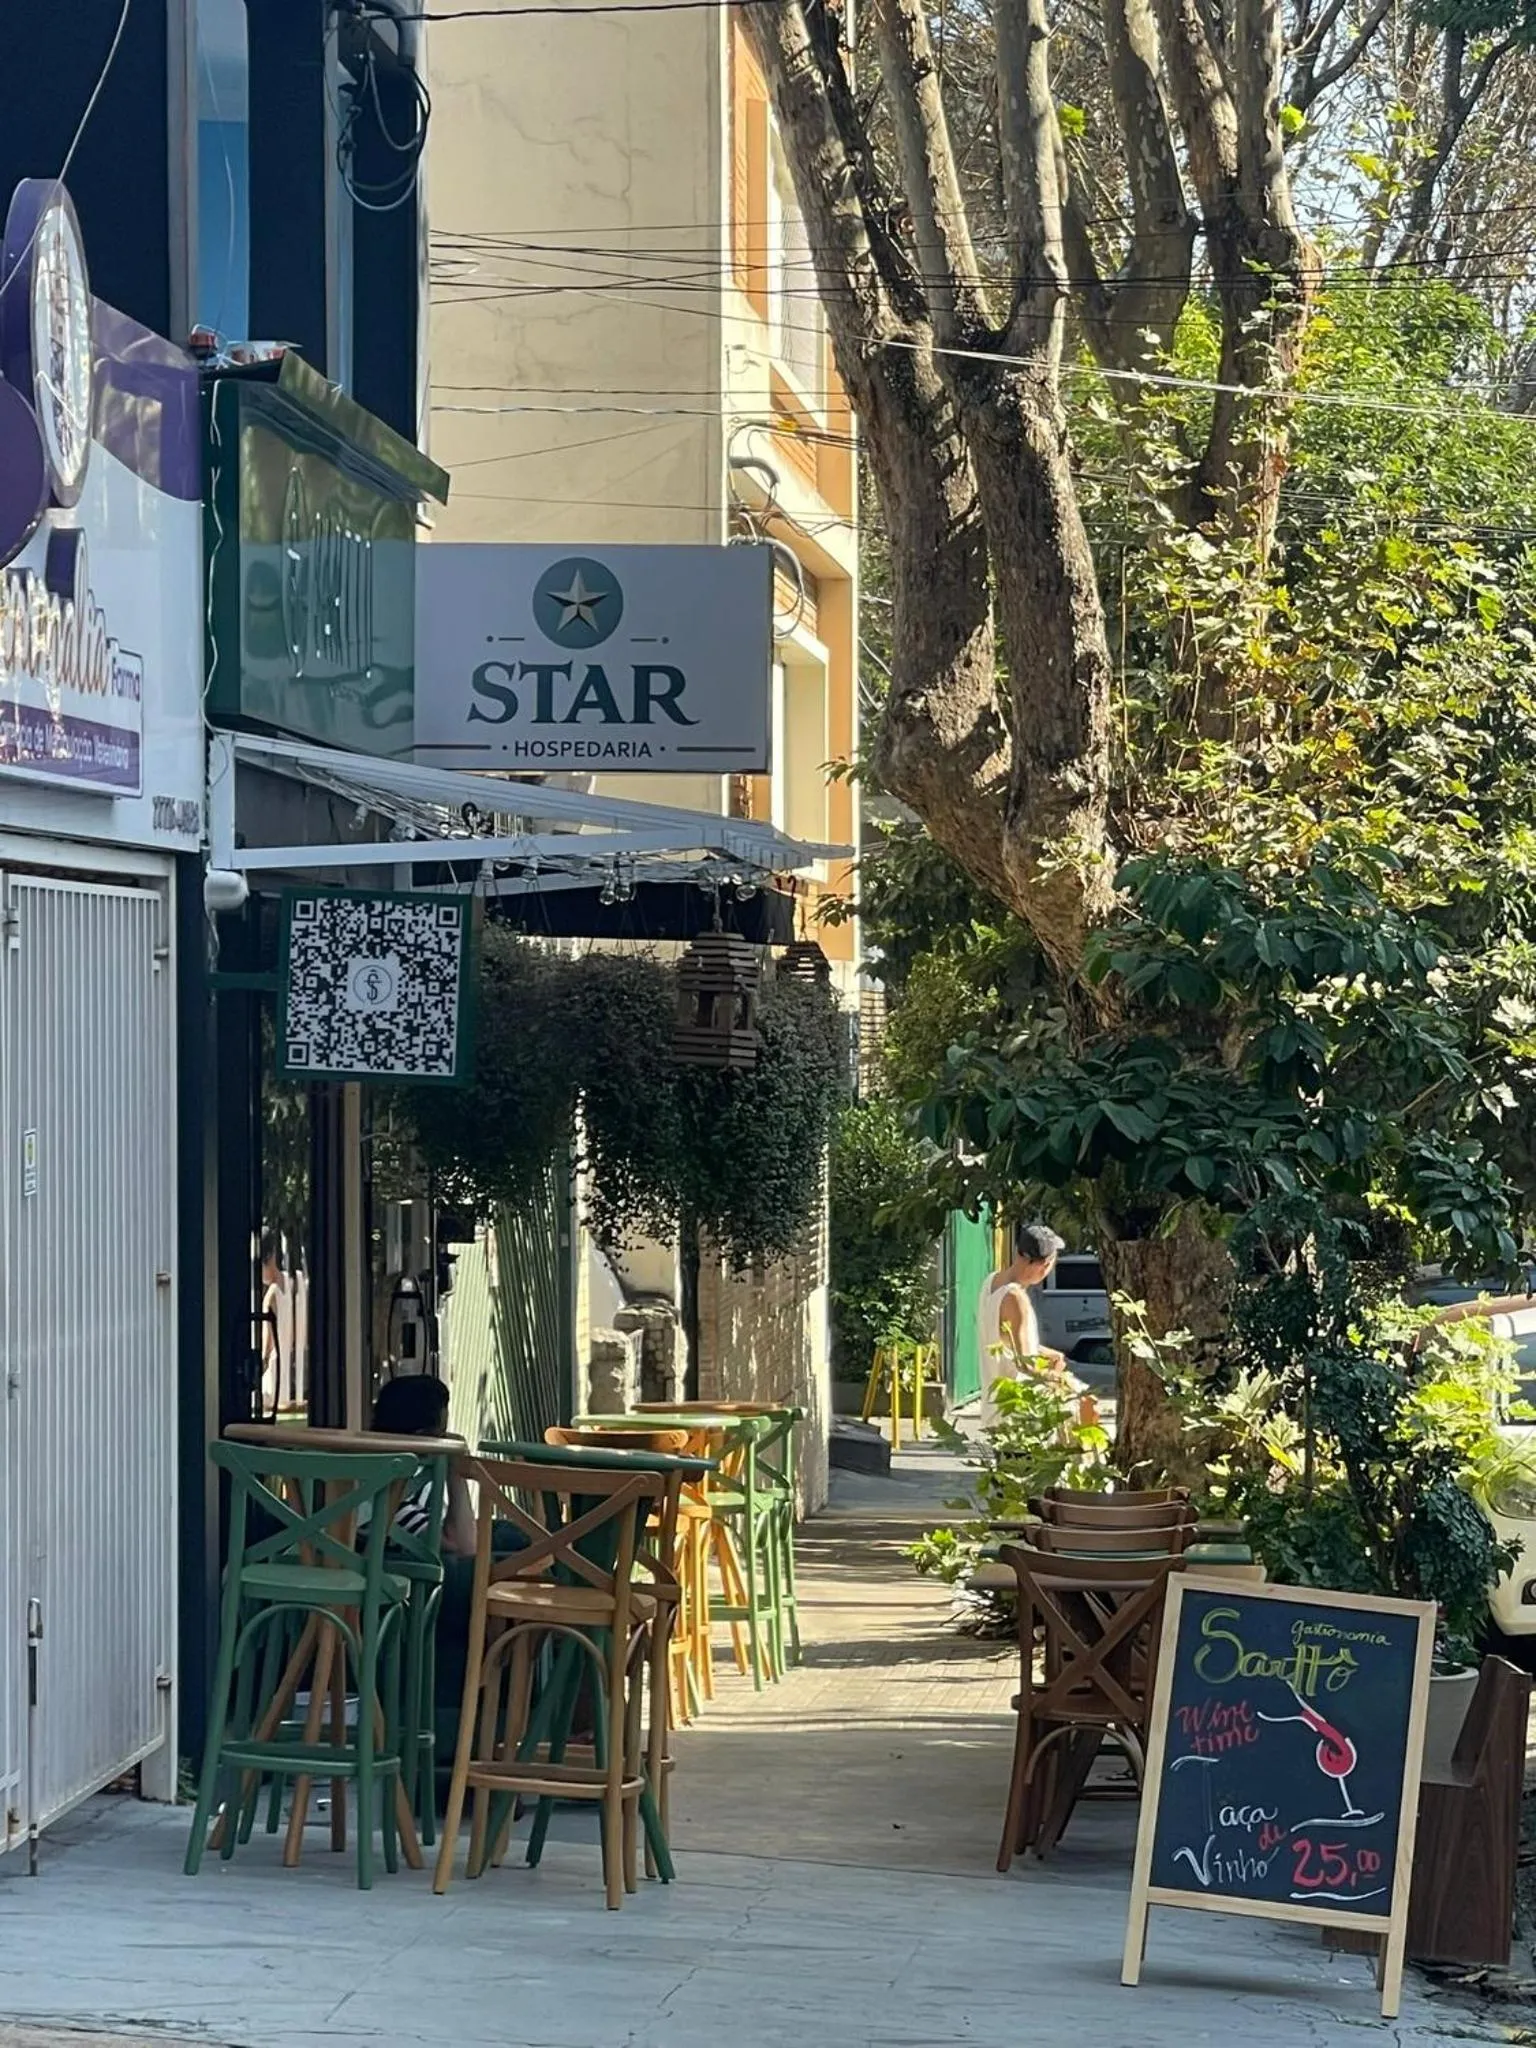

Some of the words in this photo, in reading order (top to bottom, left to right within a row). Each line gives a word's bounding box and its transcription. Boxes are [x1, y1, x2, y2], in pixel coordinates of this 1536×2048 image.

[111, 656, 141, 702] Farma
[466, 660, 701, 726] STAR
[514, 740, 653, 758] HOSPEDARIA
[1175, 1698, 1256, 1733] Wine
[1190, 1725, 1261, 1757] time
[1173, 1833, 1280, 1886] Vinho
[1291, 1837, 1381, 1890] 25,00
